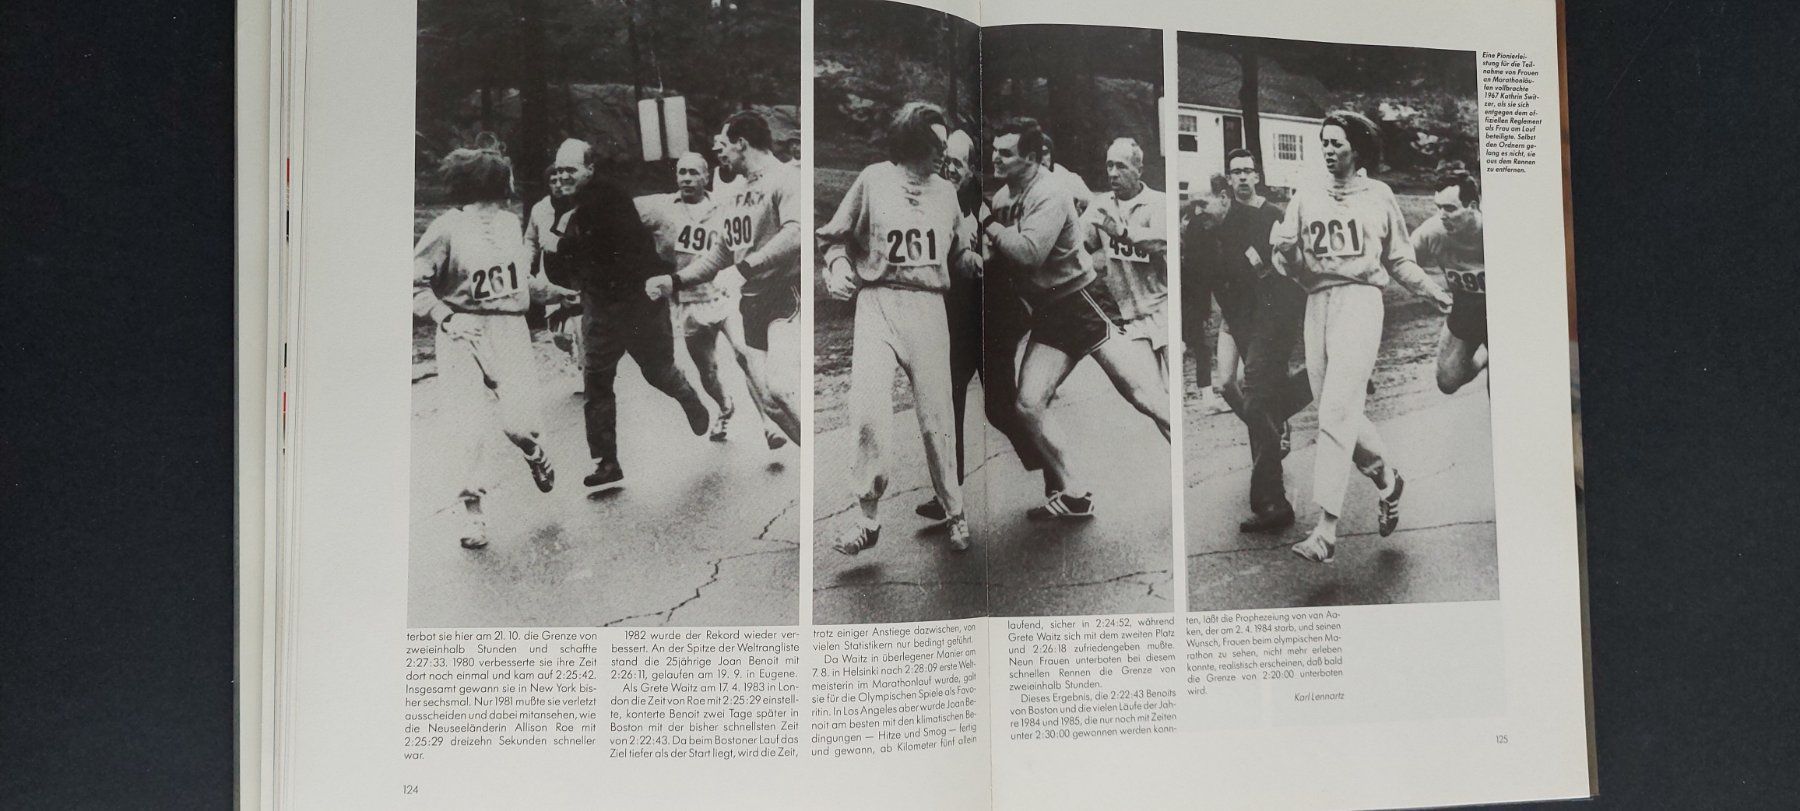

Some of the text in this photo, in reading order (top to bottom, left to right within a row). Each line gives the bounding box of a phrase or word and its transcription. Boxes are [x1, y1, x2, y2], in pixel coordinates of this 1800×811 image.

[1499, 141, 1525, 149] Ordnern
[724, 215, 752, 247] 390
[1310, 218, 1360, 254] 261
[887, 228, 936, 263] 261
[472, 262, 518, 300] 261
[1007, 620, 1044, 630] laufend,
[1050, 620, 1076, 629] sicher
[1082, 620, 1090, 628] in
[1138, 617, 1175, 626] während
[625, 631, 646, 640] 1982
[650, 632, 681, 640] wurde
[685, 630, 701, 640] der
[706, 630, 740, 640] Rekord
[744, 630, 777, 639] wieder
[813, 624, 976, 640] trotz einiger Anstiege dazwischen, von
[406, 644, 598, 654] zweieinhalb Stunden und schaffte
[612, 643, 800, 655] bessert. An der Spitze der Weltrangliste
[813, 642, 840, 651] vielen
[844, 640, 893, 651] Statistikern
[897, 641, 911, 649] nur
[914, 638, 945, 649] bedingt
[1009, 645, 1026, 655] und
[1033, 644, 1067, 654] 2:26:18
[1074, 642, 1140, 653] zufriedengeben
[824, 654, 839, 664] Da
[841, 654, 868, 664] Waitz
[871, 654, 879, 662] in
[882, 652, 934, 663] überlegener
[937, 650, 963, 659] Manier
[1187, 651, 1213, 660] rathon
[1264, 647, 1282, 656] nicht
[1287, 646, 1307, 655] mehr
[1312, 645, 1343, 654] erleben
[453, 657, 475, 667] 1980
[479, 658, 535, 667] verbesserte
[557, 657, 575, 667] ihre
[579, 657, 597, 667] Zeit
[611, 656, 799, 668] stand die 25jährige Joan Benoit mit
[1009, 653, 1176, 667] Neun Frauen unterboten bei diesem
[1219, 660, 1258, 670] realistisch
[1260, 659, 1305, 668] erscheinen,
[1307, 657, 1323, 666] daß
[1324, 656, 1343, 666] bald
[611, 670, 648, 680] 2:26:11,
[652, 669, 694, 682] gelaufen
[718, 669, 730, 679] 19.
[734, 669, 742, 679] 9.
[747, 670, 755, 678] in
[760, 669, 798, 681] Eugene.
[1009, 669, 1050, 679] schnellen
[1059, 668, 1091, 677] Rennen
[1099, 666, 1113, 676] die
[1121, 666, 1153, 675] Grenze
[1187, 674, 1201, 684] die
[1206, 673, 1237, 683] Grenze
[1263, 670, 1295, 680] 2:20:00
[1300, 669, 1343, 678] unterboten
[812, 681, 854, 691] meisterin
[872, 676, 932, 688] Marathonlauf
[934, 674, 961, 684] wurde,
[1009, 681, 1062, 691] zweieinhalb
[406, 684, 597, 696] Insgesamt gewann sie in New York bis-
[1294, 692, 1345, 702] Karl Lennartz
[405, 710, 467, 721] ausscheiden
[468, 710, 488, 720] und
[489, 710, 518, 720] dabei
[519, 711, 578, 720] mitansehen,
[405, 723, 596, 733] die Neuseeländerin Allison Roe mit
[611, 721, 799, 732] Boston mit der bisher schnellsten Zeit
[405, 736, 596, 747] 2:25:29 dreizehn Sekunden schneller
[1496, 735, 1508, 744] 125
[403, 784, 418, 794] 124
